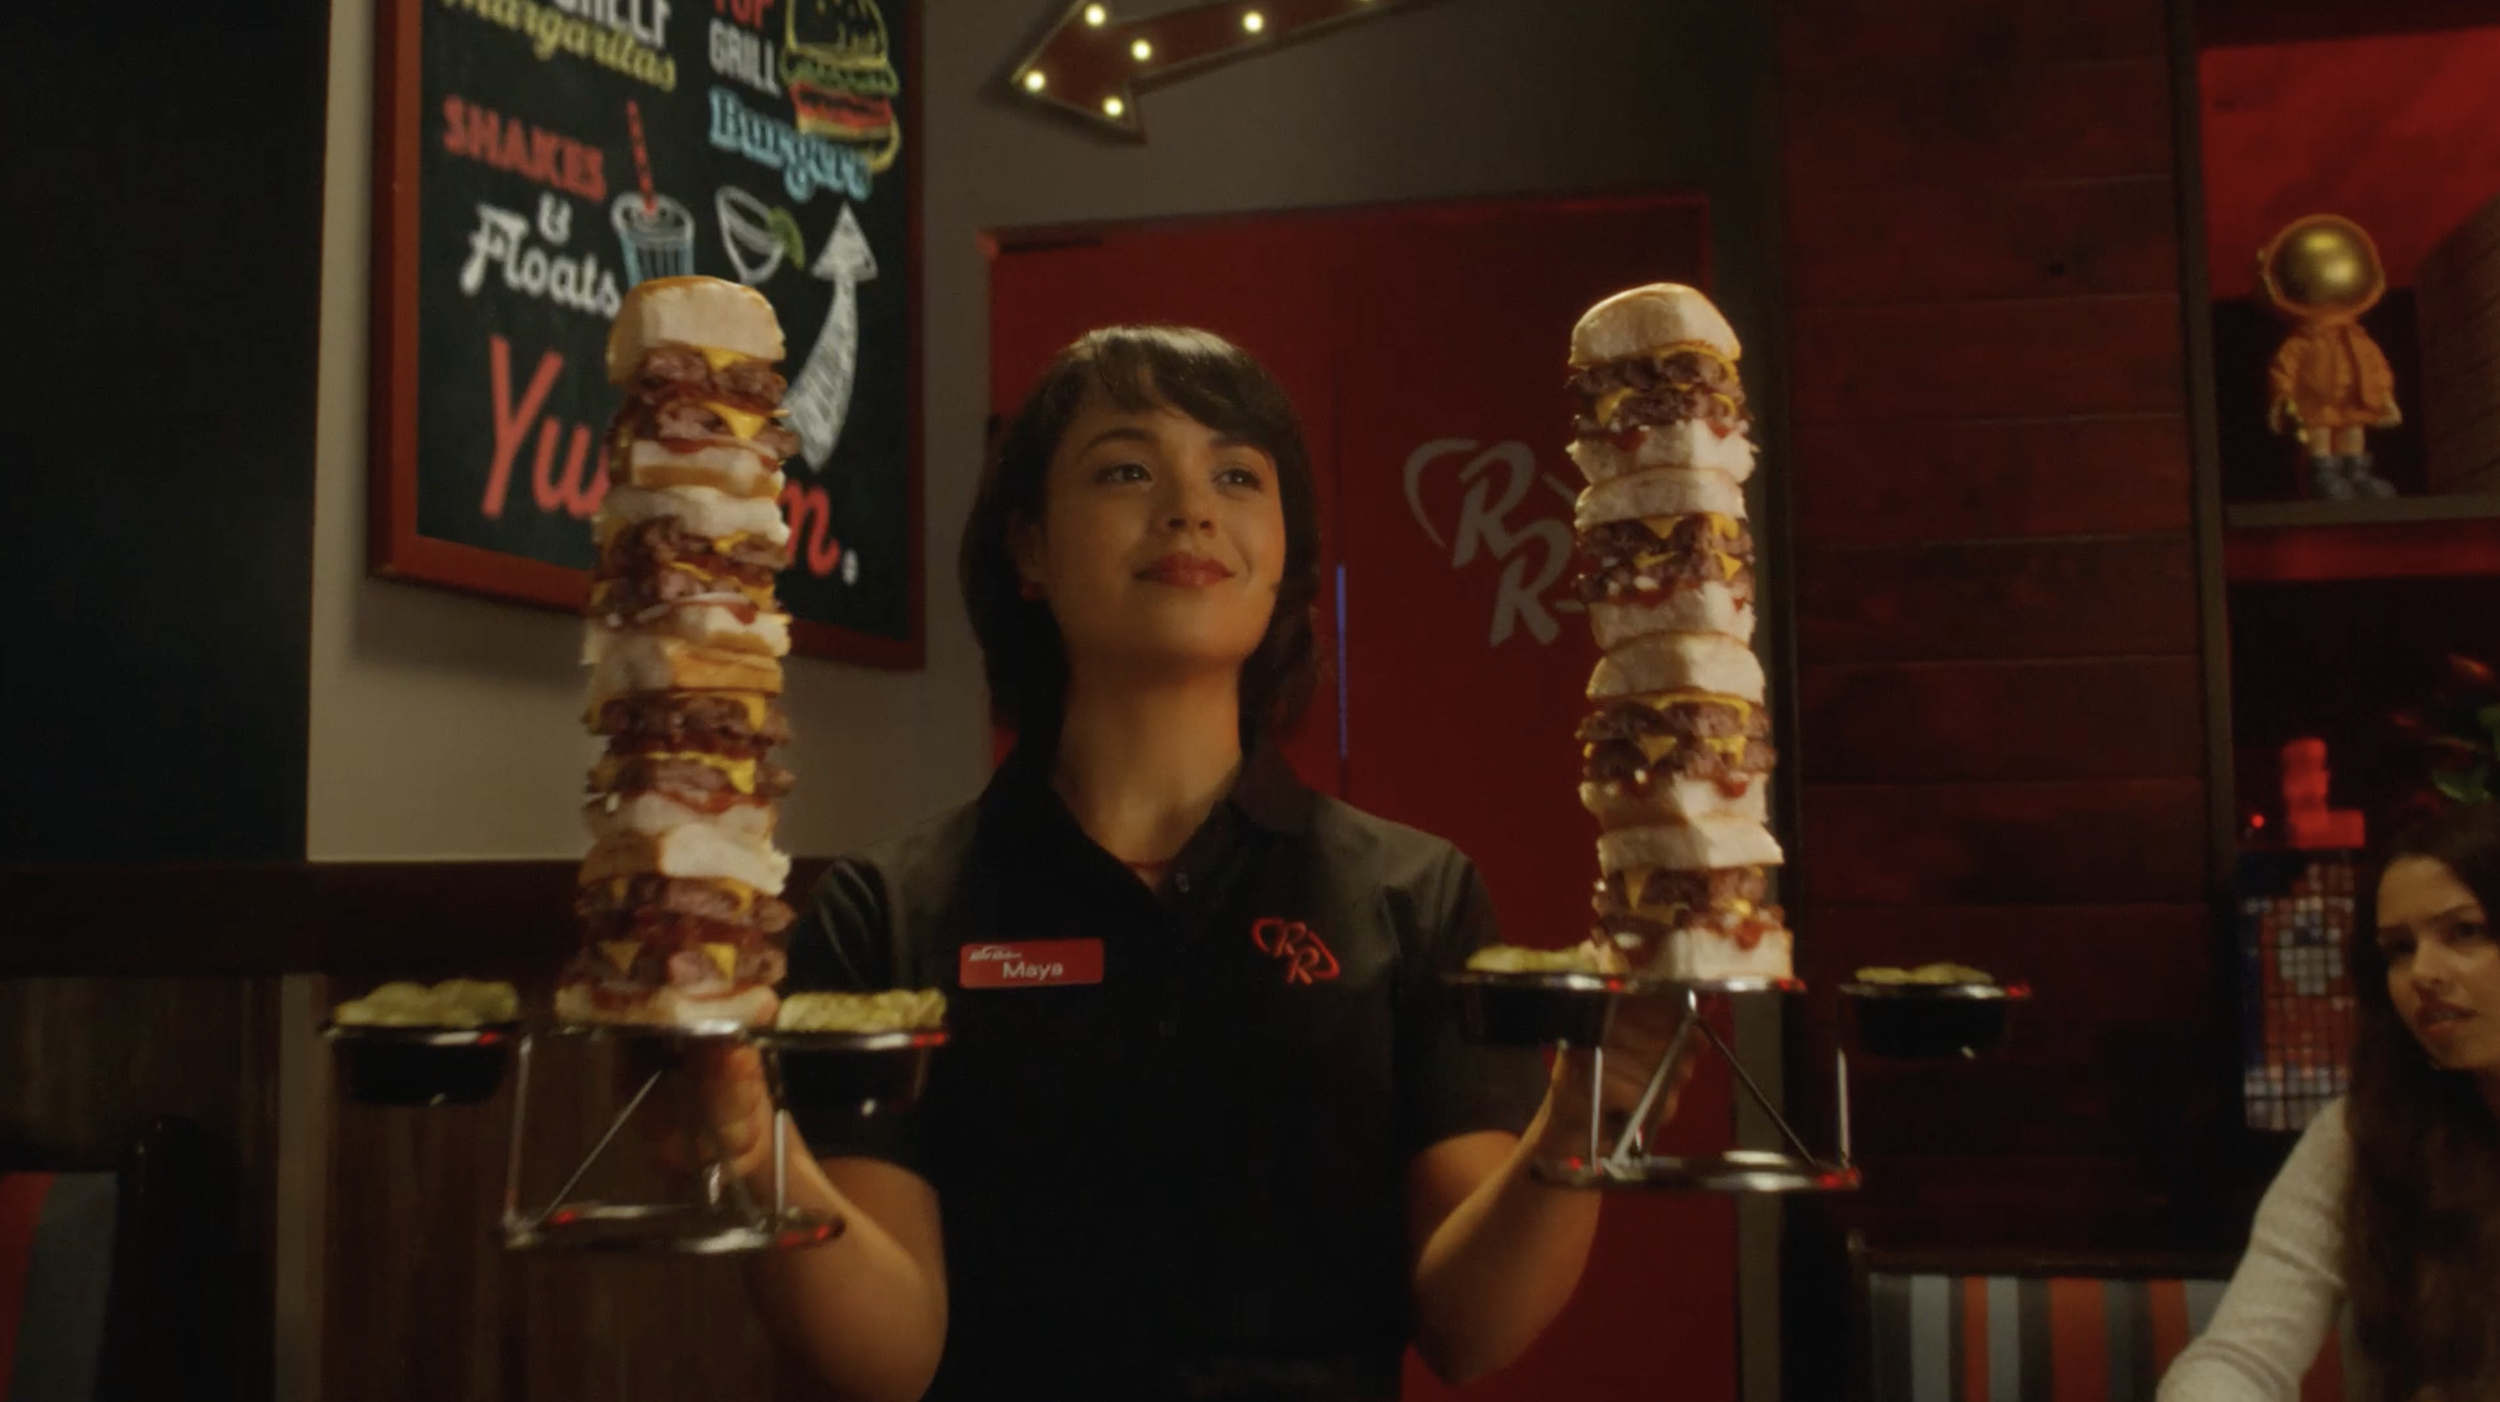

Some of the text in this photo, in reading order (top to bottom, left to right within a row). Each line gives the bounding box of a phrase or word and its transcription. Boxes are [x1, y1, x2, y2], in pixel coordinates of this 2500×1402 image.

[441, 0, 677, 92] argaritas
[709, 17, 782, 99] GRILL
[441, 94, 608, 203] SHAKES
[460, 202, 622, 320] Floats
[1002, 960, 1064, 982] Maya
